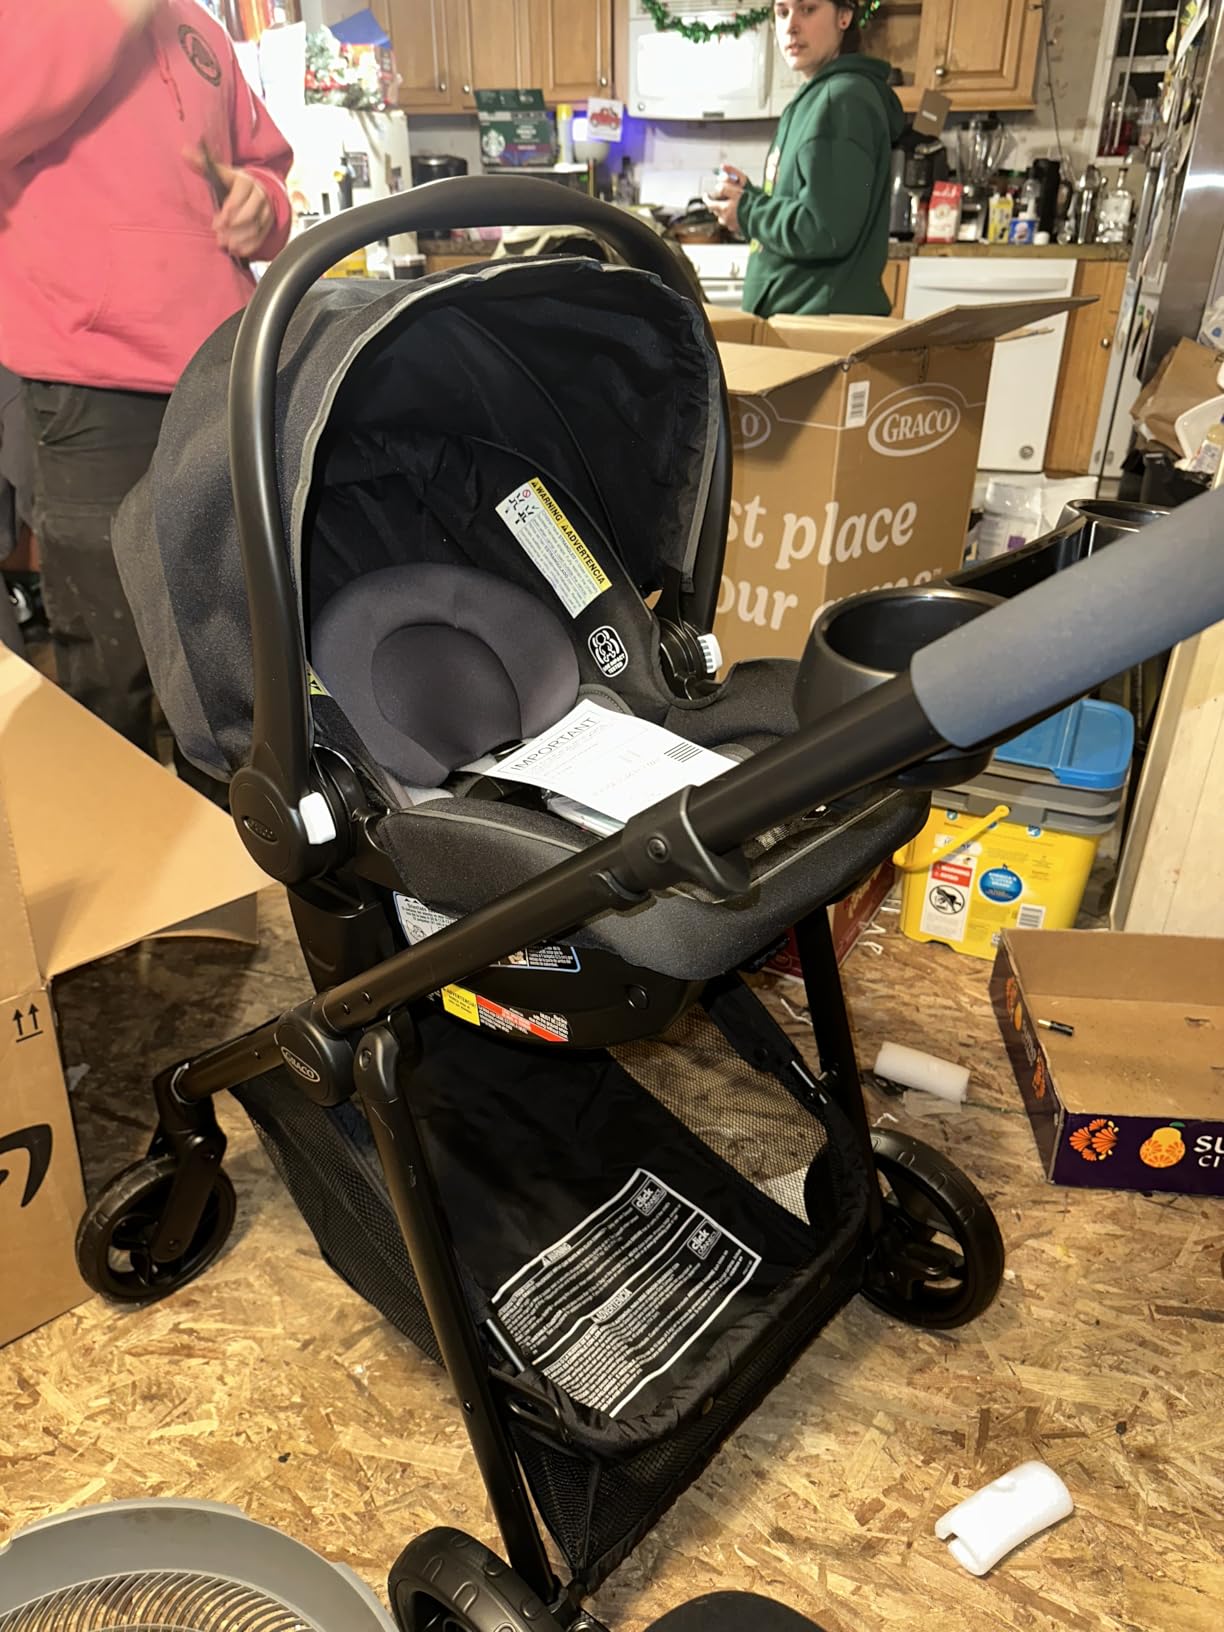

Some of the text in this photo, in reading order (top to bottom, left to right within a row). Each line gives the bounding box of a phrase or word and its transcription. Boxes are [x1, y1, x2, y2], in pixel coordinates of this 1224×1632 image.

[883, 407, 952, 443] GRACO
[536, 487, 563, 521] WARNING
[565, 530, 605, 585] ADVERTENCIA
[728, 496, 767, 549] st
[775, 501, 917, 570] place
[716, 575, 798, 631] our
[511, 717, 597, 771] IMPORTANT
[284, 1052, 316, 1080] GRACO
[1193, 1135, 1224, 1154] SU
[636, 1186, 654, 1208] click
[690, 1228, 709, 1250] click
[596, 1286, 632, 1320] ADVERTENCIA
